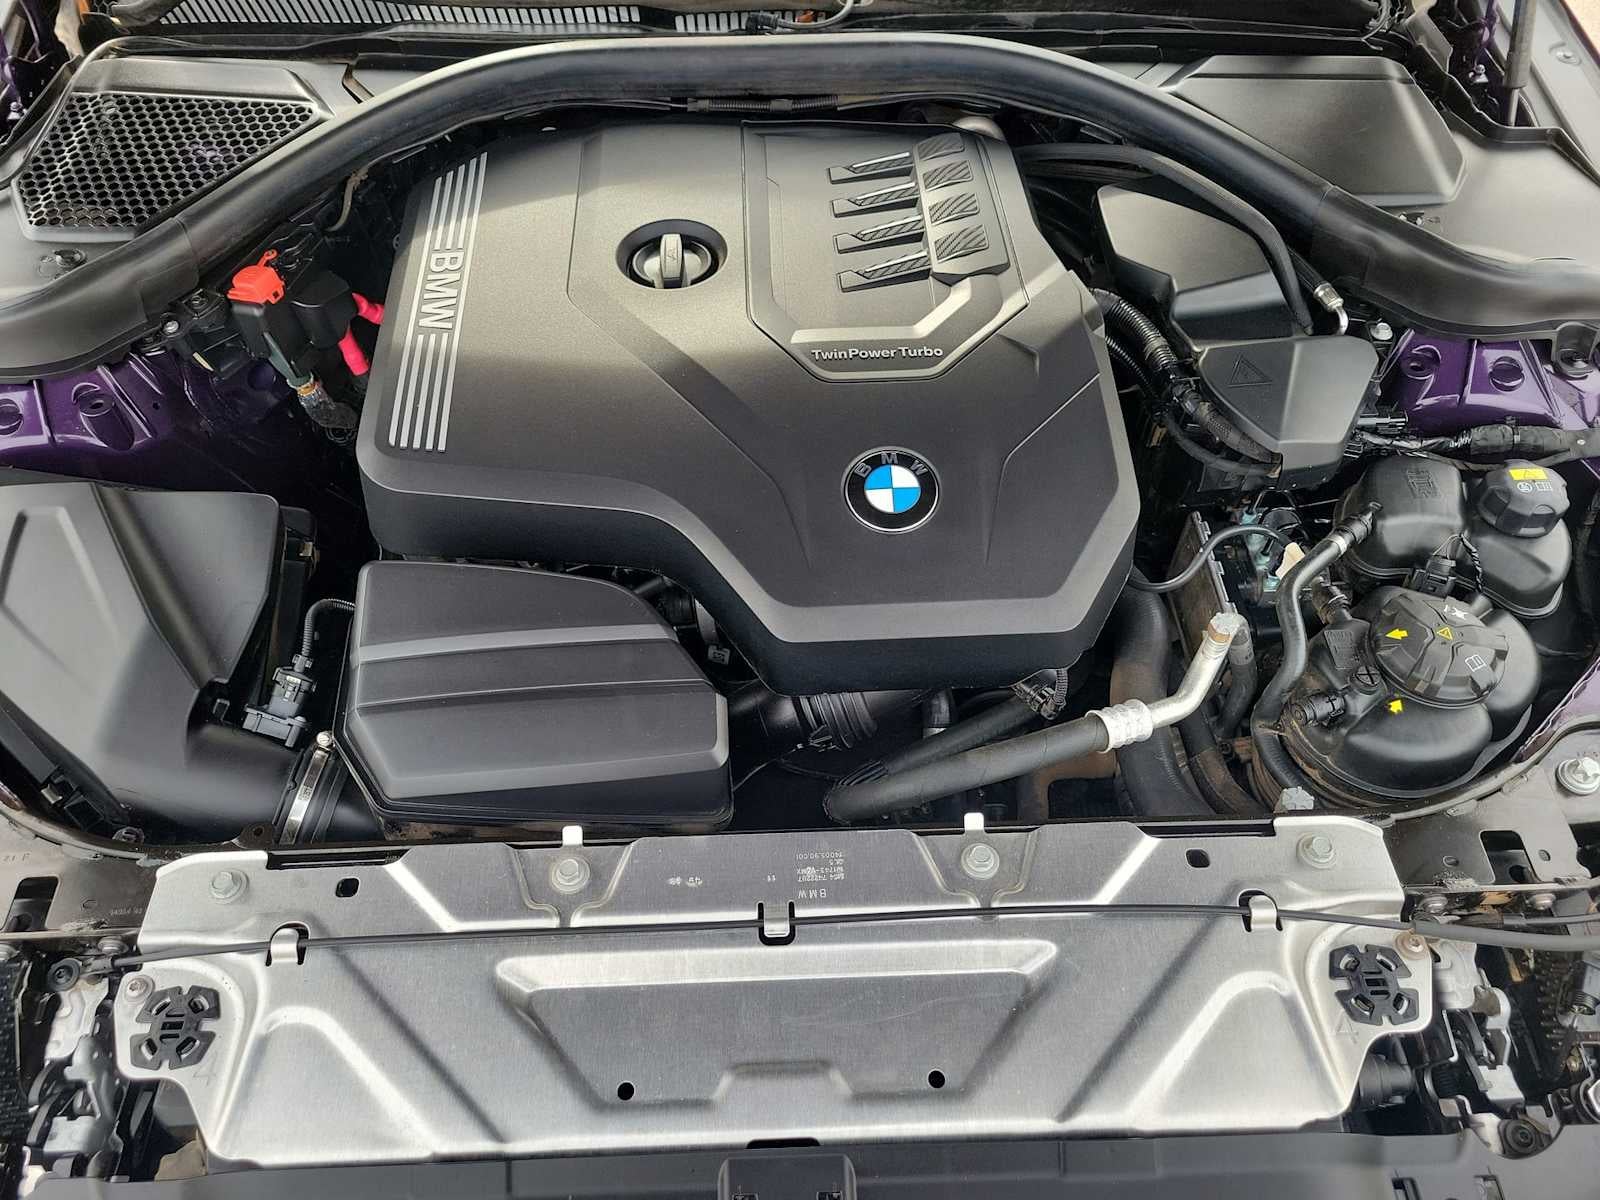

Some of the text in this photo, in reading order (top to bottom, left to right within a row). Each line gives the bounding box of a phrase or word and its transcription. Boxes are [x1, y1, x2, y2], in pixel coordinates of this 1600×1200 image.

[418, 250, 465, 330] BMW
[811, 346, 943, 360] TwinPower Turbo
[854, 452, 928, 478] BMW
